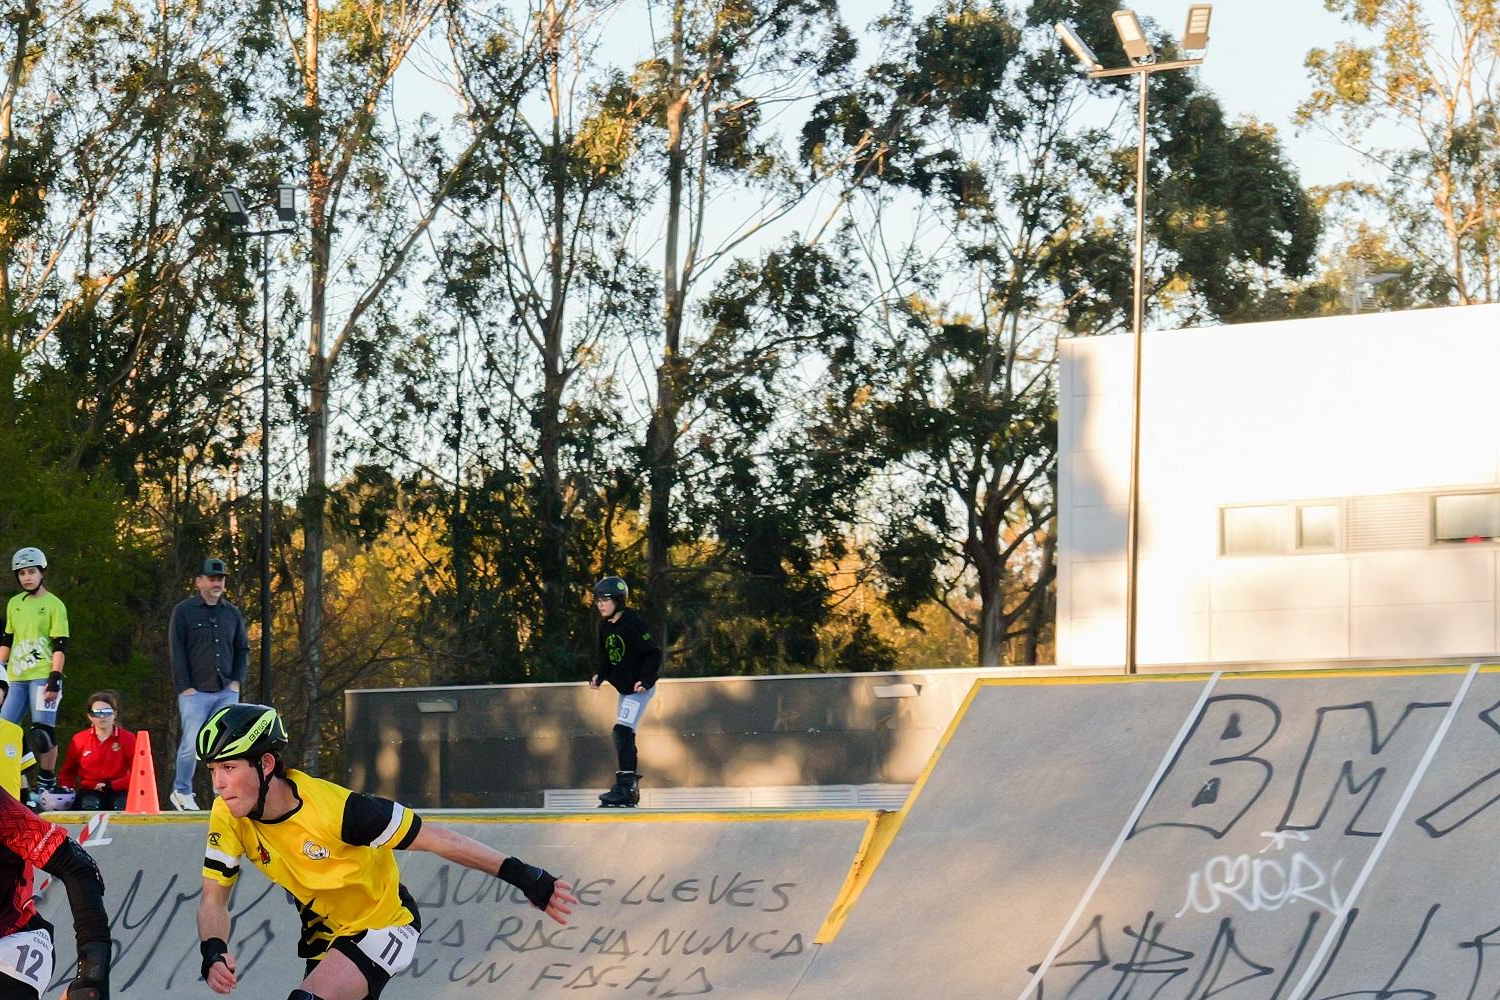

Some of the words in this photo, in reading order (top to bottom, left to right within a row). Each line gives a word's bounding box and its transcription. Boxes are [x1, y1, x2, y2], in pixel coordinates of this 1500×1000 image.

[248, 720, 268, 742] BRIKO
[417, 864, 616, 909] AUNE
[620, 871, 797, 912] LLEVES
[380, 931, 404, 967] 11
[486, 915, 638, 960] RACHA
[642, 927, 804, 960] NUNCA
[15, 943, 44, 982] 12
